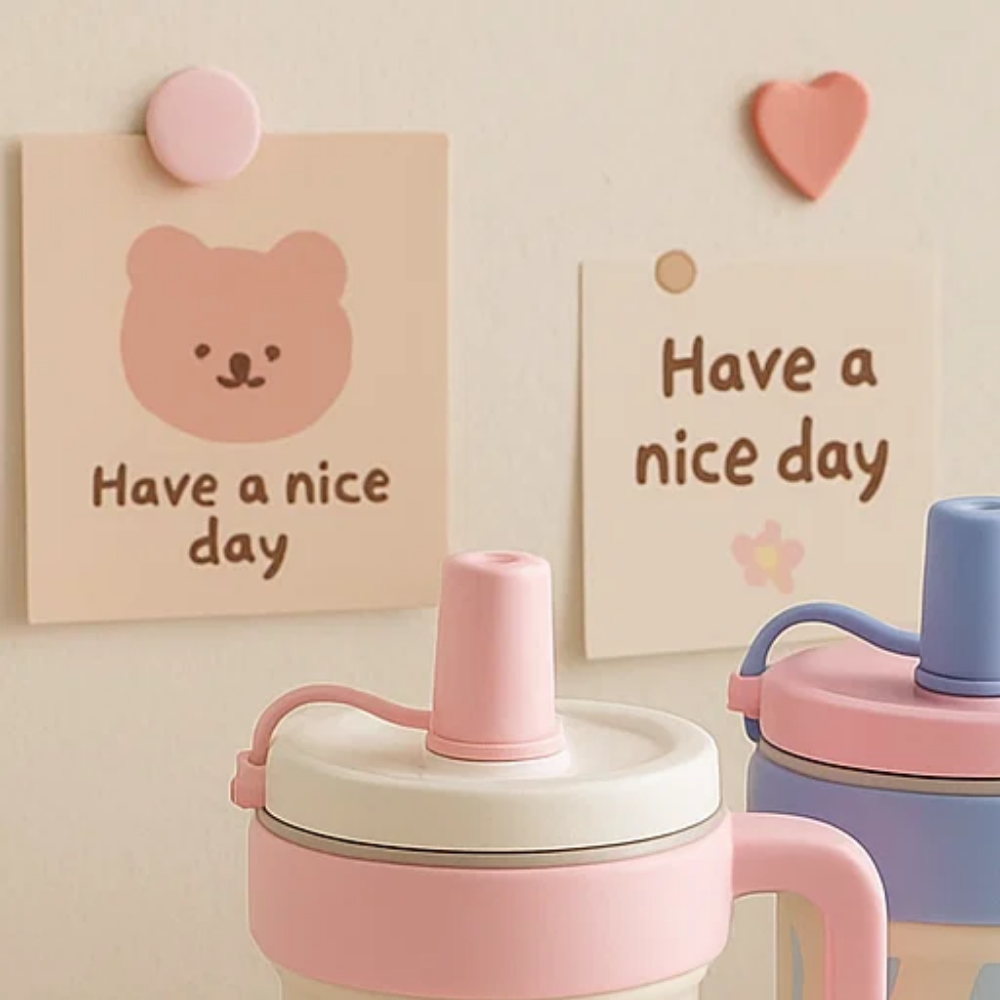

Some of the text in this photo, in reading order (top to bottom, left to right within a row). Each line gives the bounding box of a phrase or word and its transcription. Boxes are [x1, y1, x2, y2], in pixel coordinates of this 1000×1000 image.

[661, 334, 878, 399] Have a
[92, 459, 391, 508] Have a nice
[635, 414, 890, 504] nice day
[188, 515, 290, 581] day
